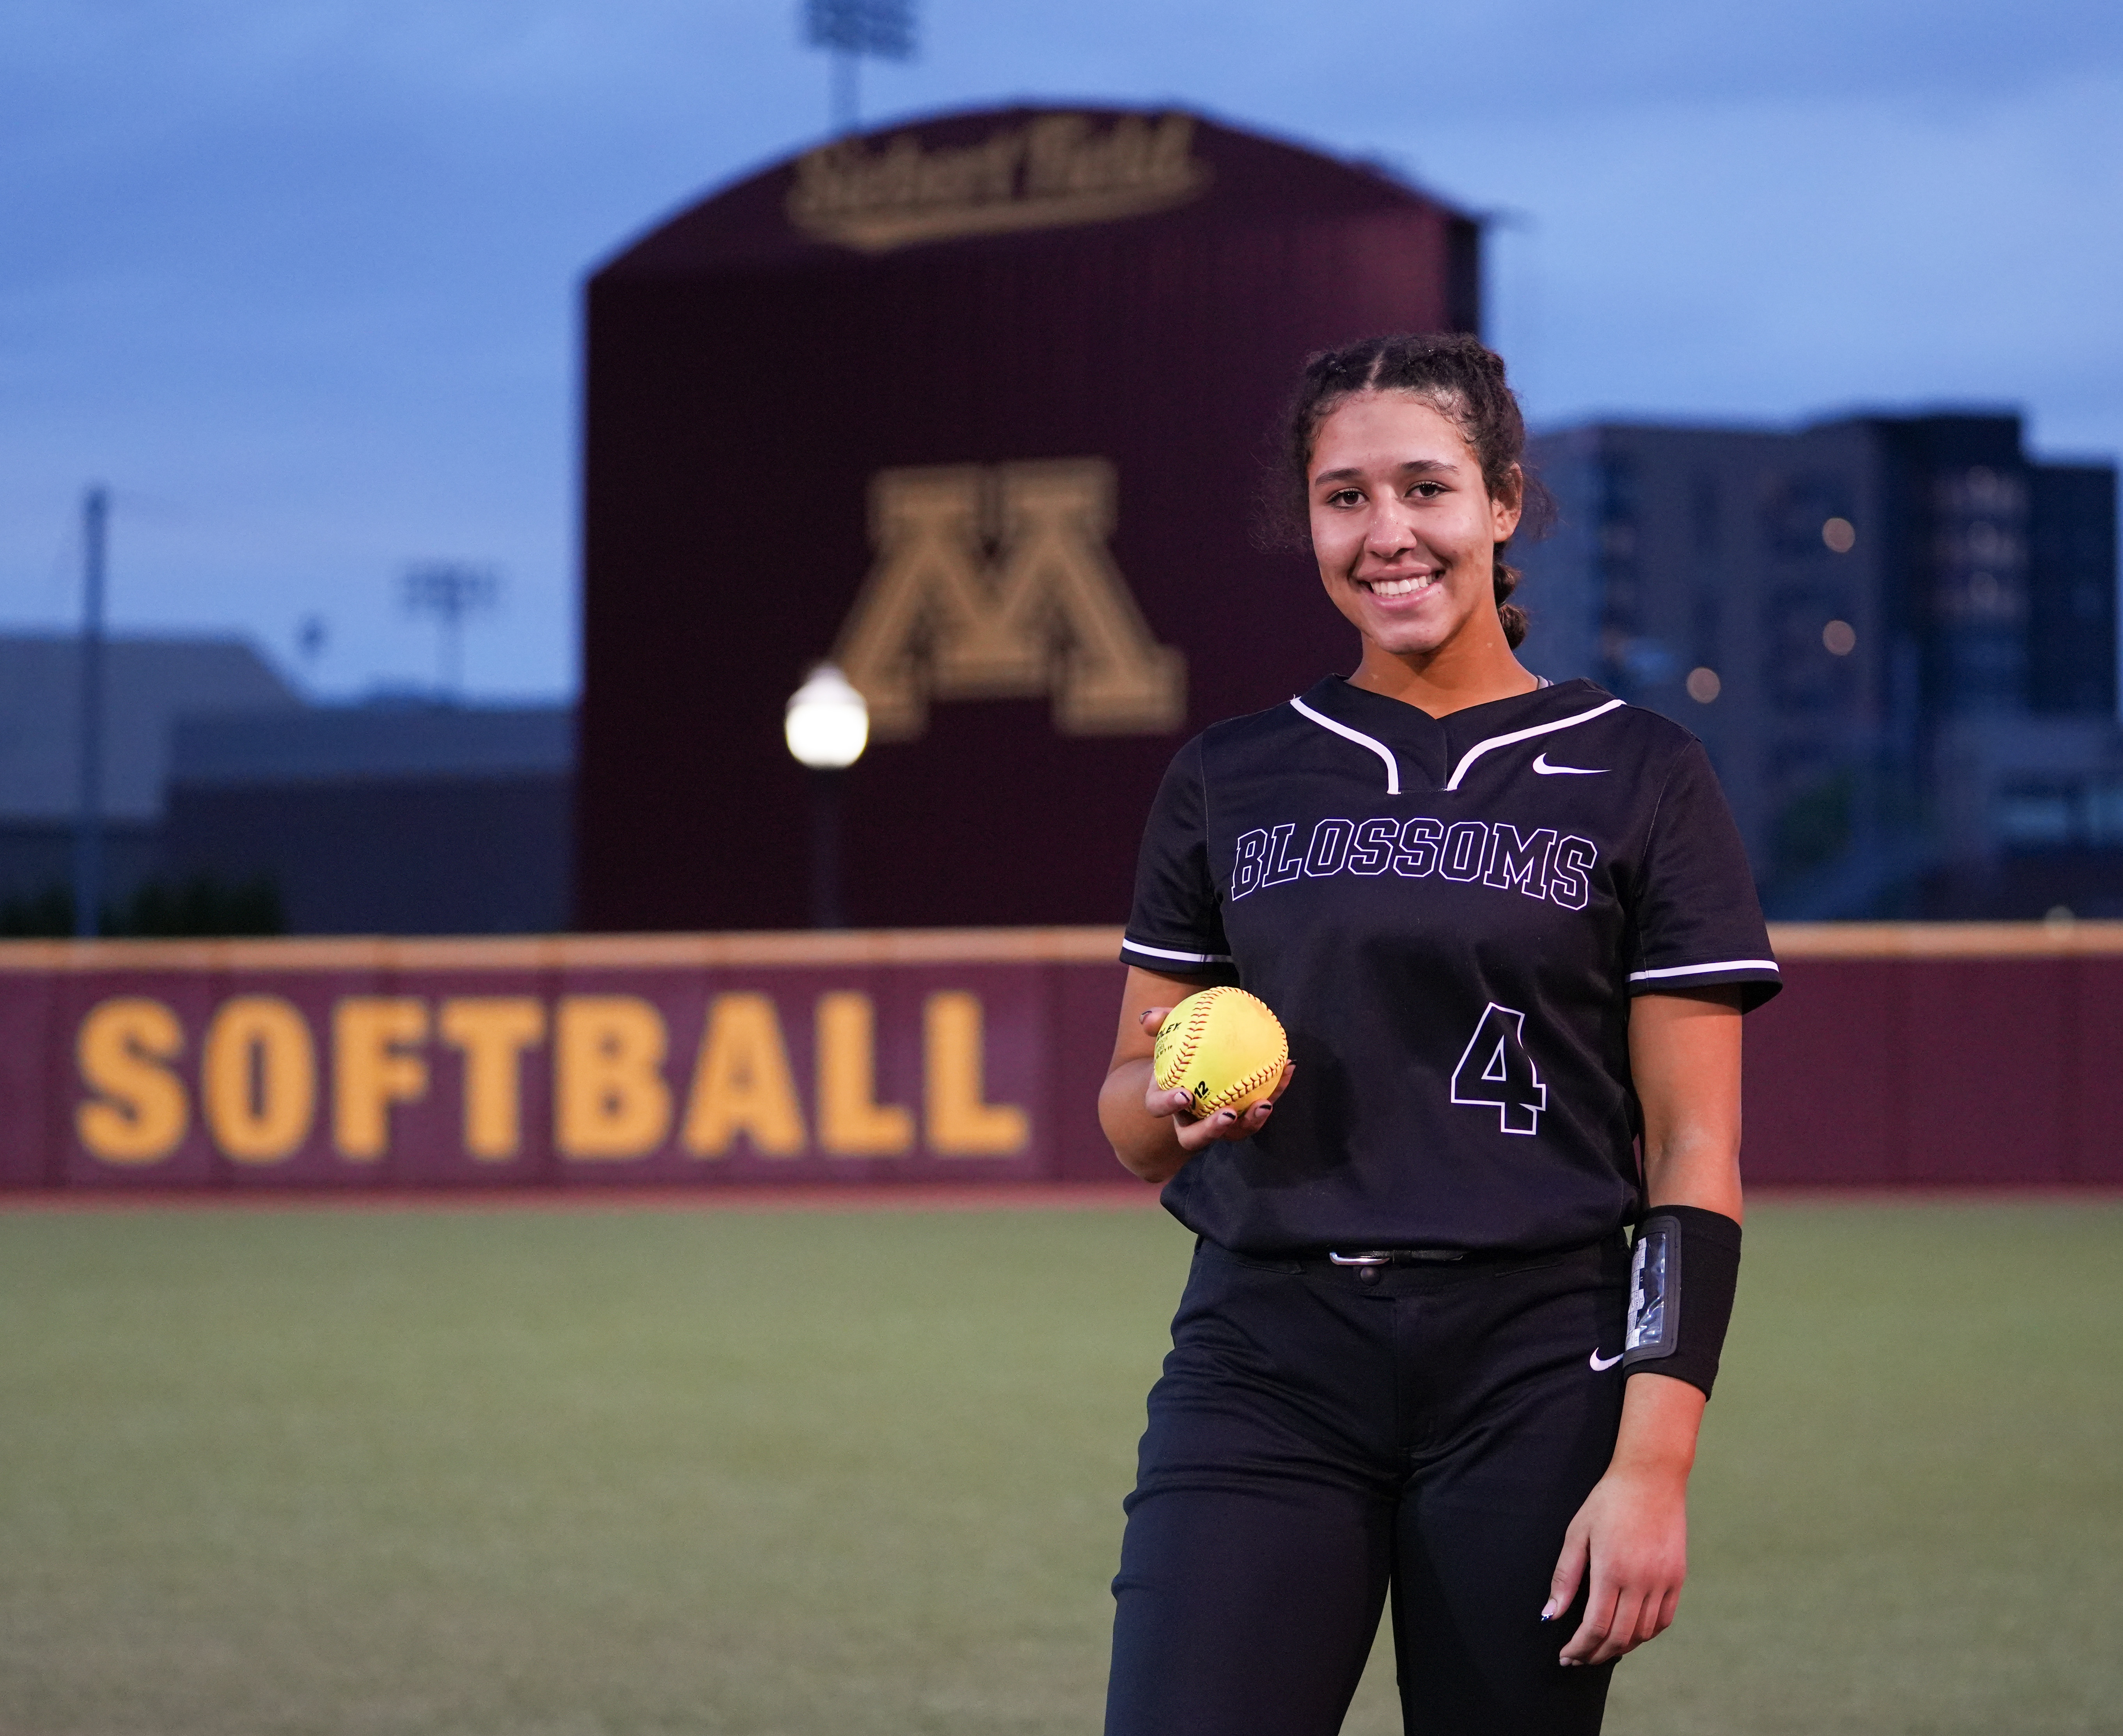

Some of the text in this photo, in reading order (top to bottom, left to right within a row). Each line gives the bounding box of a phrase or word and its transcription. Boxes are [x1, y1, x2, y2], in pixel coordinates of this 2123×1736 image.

[1231, 818, 1597, 911] BLOSSOMS
[75, 991, 1030, 1166] SOFTBALL
[1194, 1081, 1209, 1099] 12
[1451, 1002, 1546, 1135] 4
